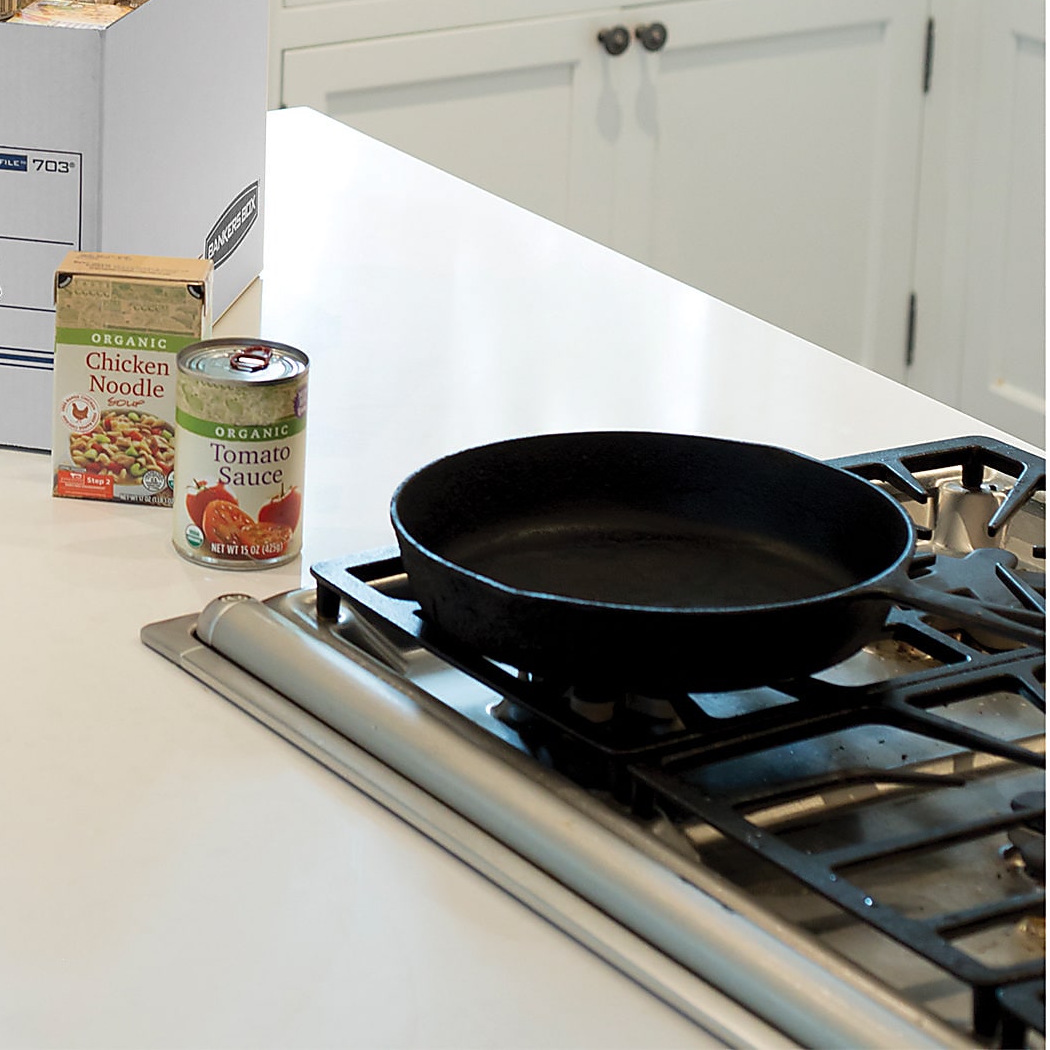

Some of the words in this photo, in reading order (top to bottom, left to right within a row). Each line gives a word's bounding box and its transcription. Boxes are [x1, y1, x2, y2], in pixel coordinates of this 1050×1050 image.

[208, 210, 241, 259] BANKERS
[241, 194, 256, 223] BOX
[91, 333, 167, 349] ORGANIC
[86, 352, 169, 376] Chicken
[89, 375, 165, 398] Noodle
[215, 425, 289, 439] ORGANIC
[210, 442, 290, 465] Tomato
[87, 477, 104, 486] Step
[218, 466, 283, 487] Sauce
[211, 542, 225, 553] NET
[227, 545, 238, 555] WT
[241, 546, 248, 555] 15
[250, 545, 260, 554] OZ
[262, 542, 283, 555] (425g)
